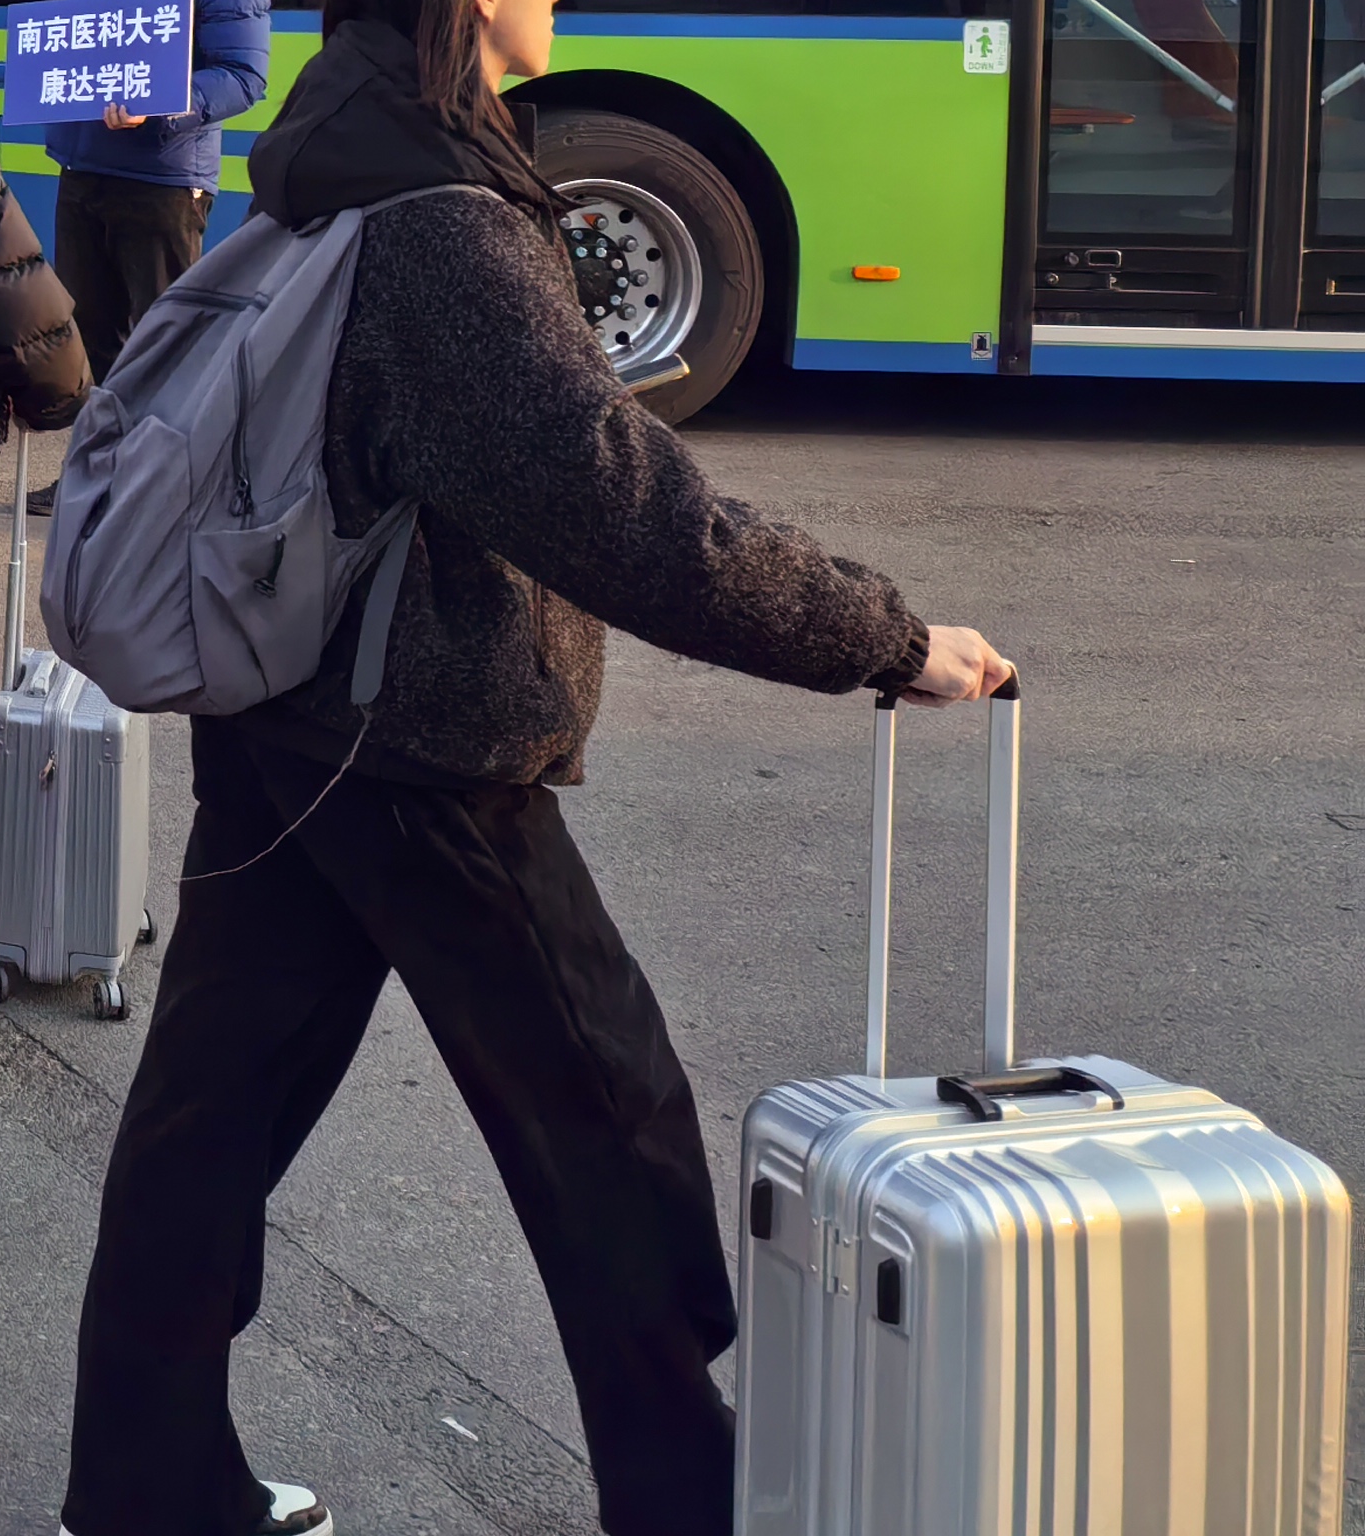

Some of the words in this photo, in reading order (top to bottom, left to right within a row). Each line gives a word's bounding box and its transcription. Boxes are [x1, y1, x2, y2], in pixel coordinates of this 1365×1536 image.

[16, 4, 181, 55] 南京医科大学
[39, 60, 151, 106] 康达学院
